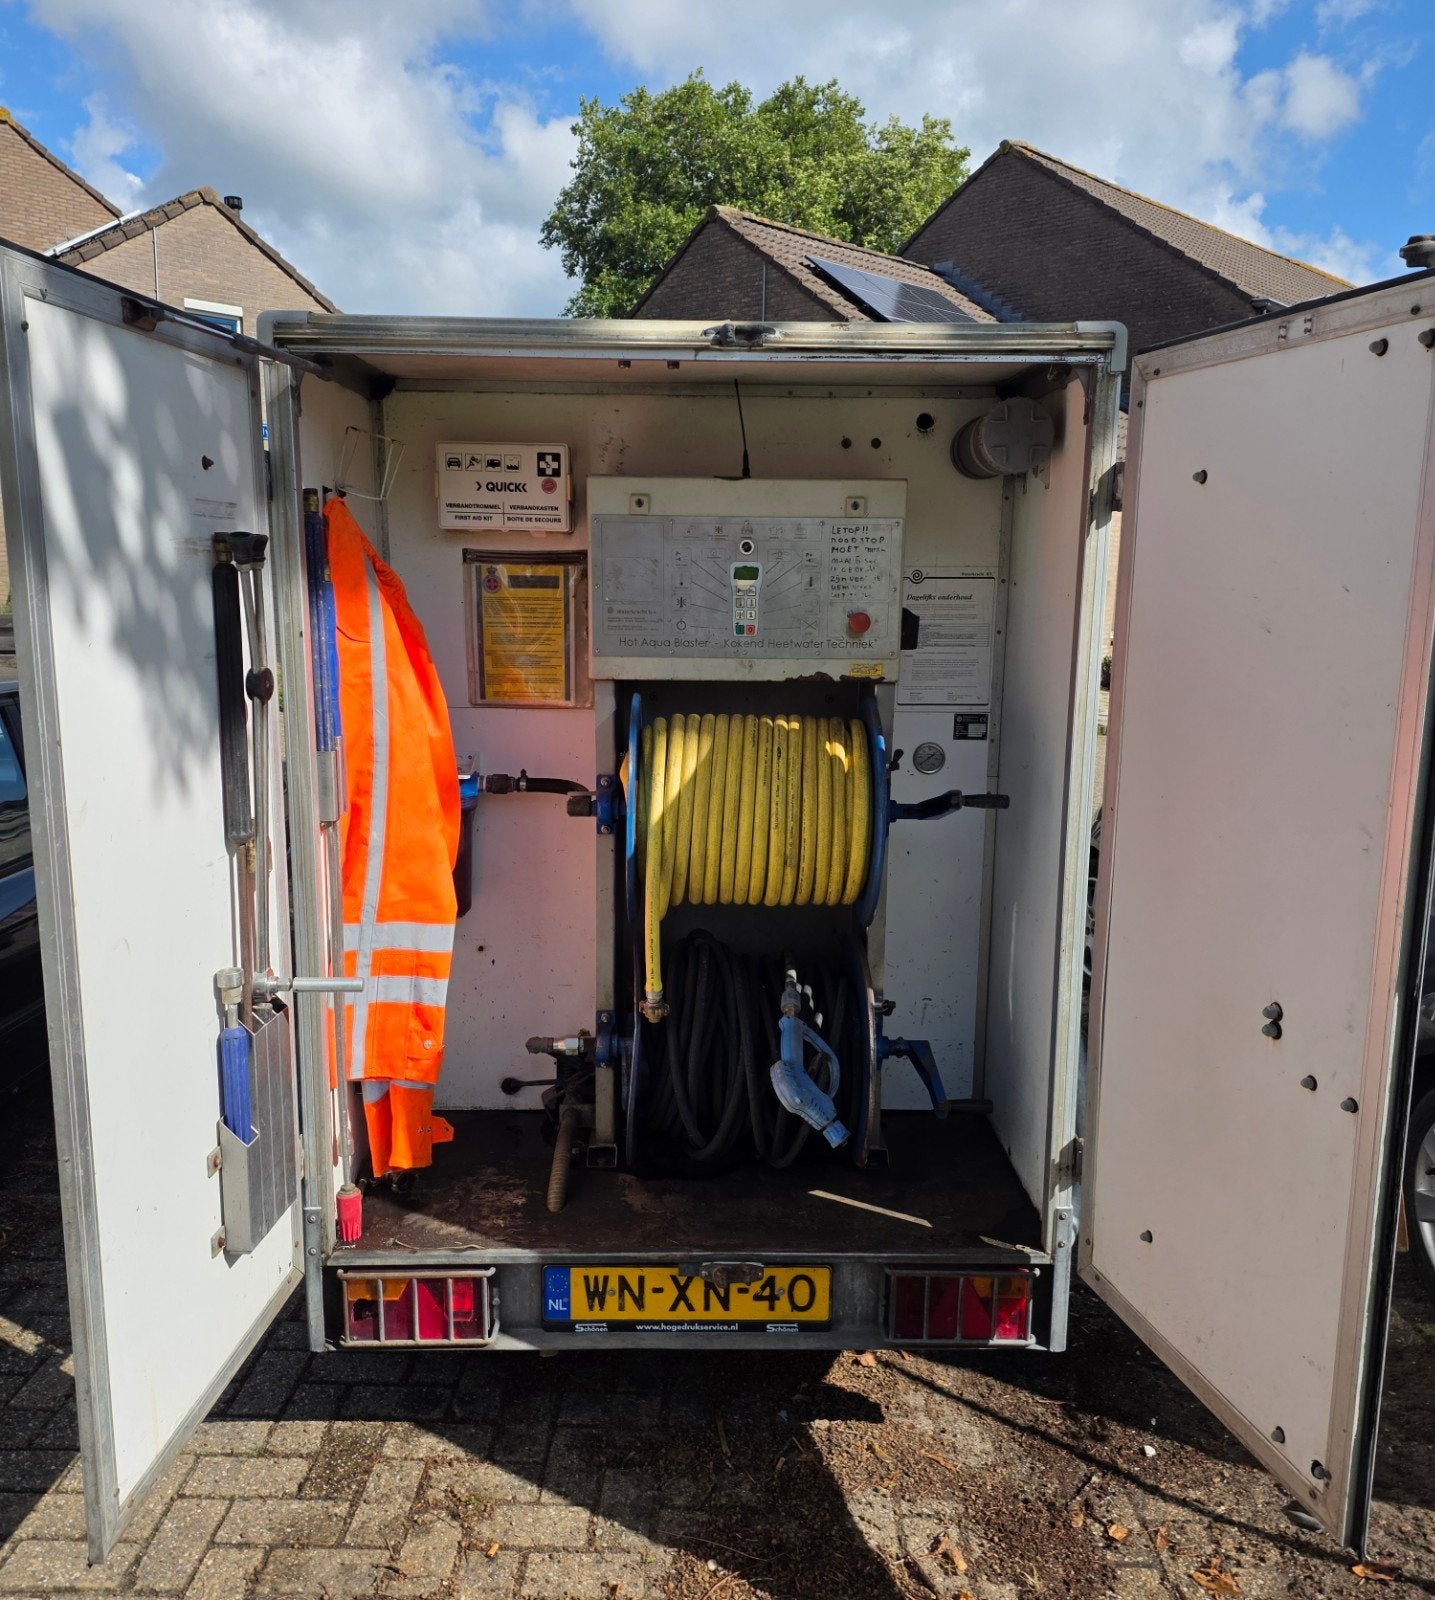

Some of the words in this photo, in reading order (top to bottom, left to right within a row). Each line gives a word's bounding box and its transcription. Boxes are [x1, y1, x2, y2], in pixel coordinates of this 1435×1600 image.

[485, 481, 522, 492] QUICK
[445, 502, 501, 510] VERBANDTROMMEL
[509, 504, 559, 512] VERBANDKASTEN
[906, 594, 936, 602] Dagelijks
[619, 637, 638, 646] Hot
[641, 638, 671, 648] Aqua
[674, 638, 708, 648] Blaster
[724, 638, 764, 648] Kokend
[768, 639, 824, 648] Heetwater
[827, 639, 874, 648] Techniek
[548, 1300, 568, 1311] NL
[583, 1274, 816, 1313] WN-XN-40
[575, 1322, 608, 1332] Schönen
[636, 1323, 738, 1332] www.hogedrukservice.nl
[766, 1322, 799, 1333] Schönen
